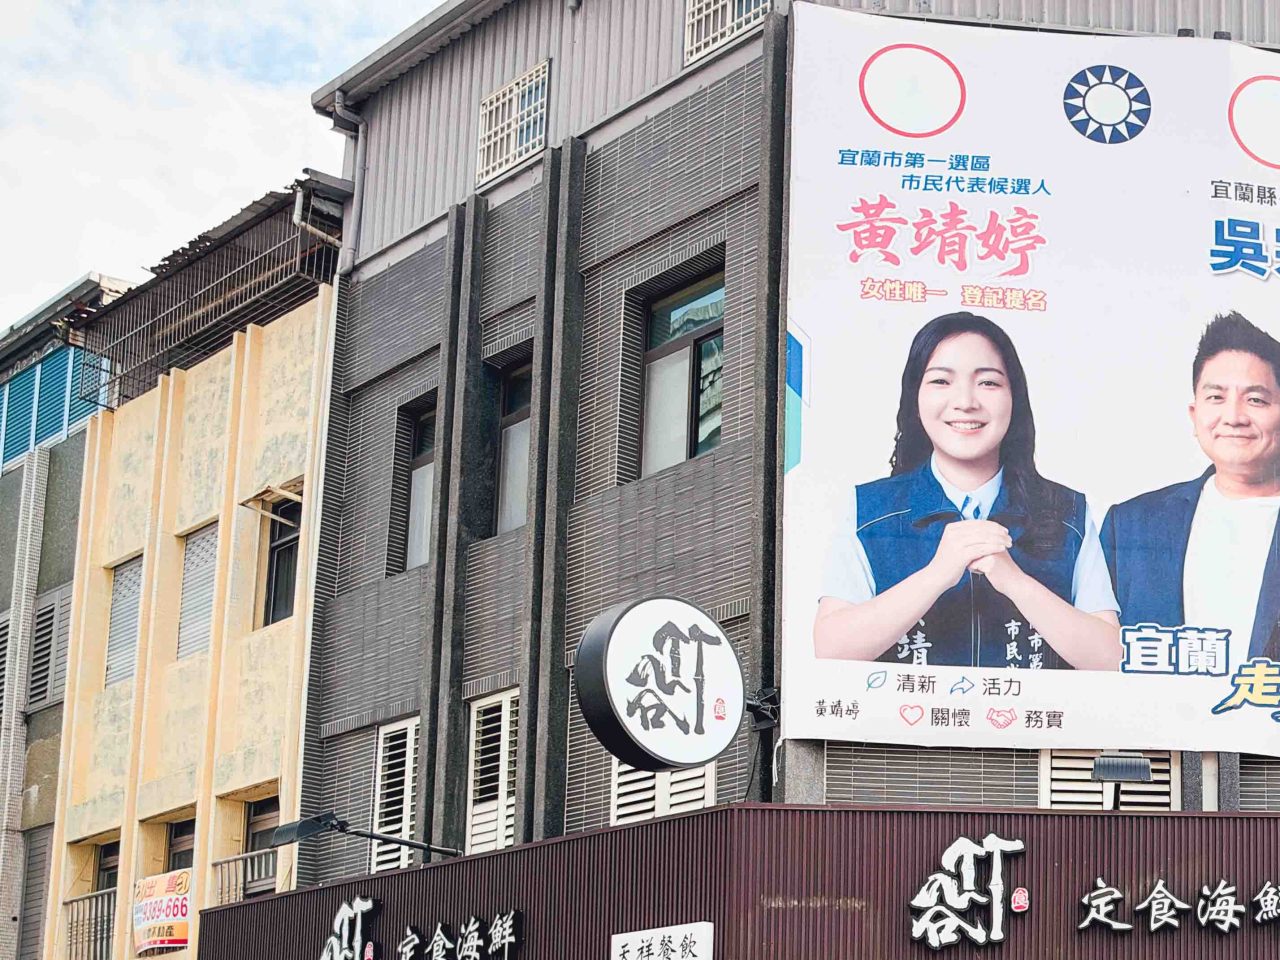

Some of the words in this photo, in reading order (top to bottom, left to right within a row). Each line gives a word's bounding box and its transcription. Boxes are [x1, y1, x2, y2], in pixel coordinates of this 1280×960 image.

[837, 149, 992, 172] 宜蘭市第一選區
[901, 174, 1052, 196] 市民代表候選人
[836, 194, 1047, 278] 黃靖婷
[860, 277, 948, 302] 女性唯一
[961, 285, 1048, 311] 登記提名
[1122, 626, 1230, 675] 宜蘭
[896, 673, 937, 694] 清新
[982, 677, 1021, 696] 活力
[931, 707, 971, 727] 關懷
[1025, 709, 1064, 729] 務實
